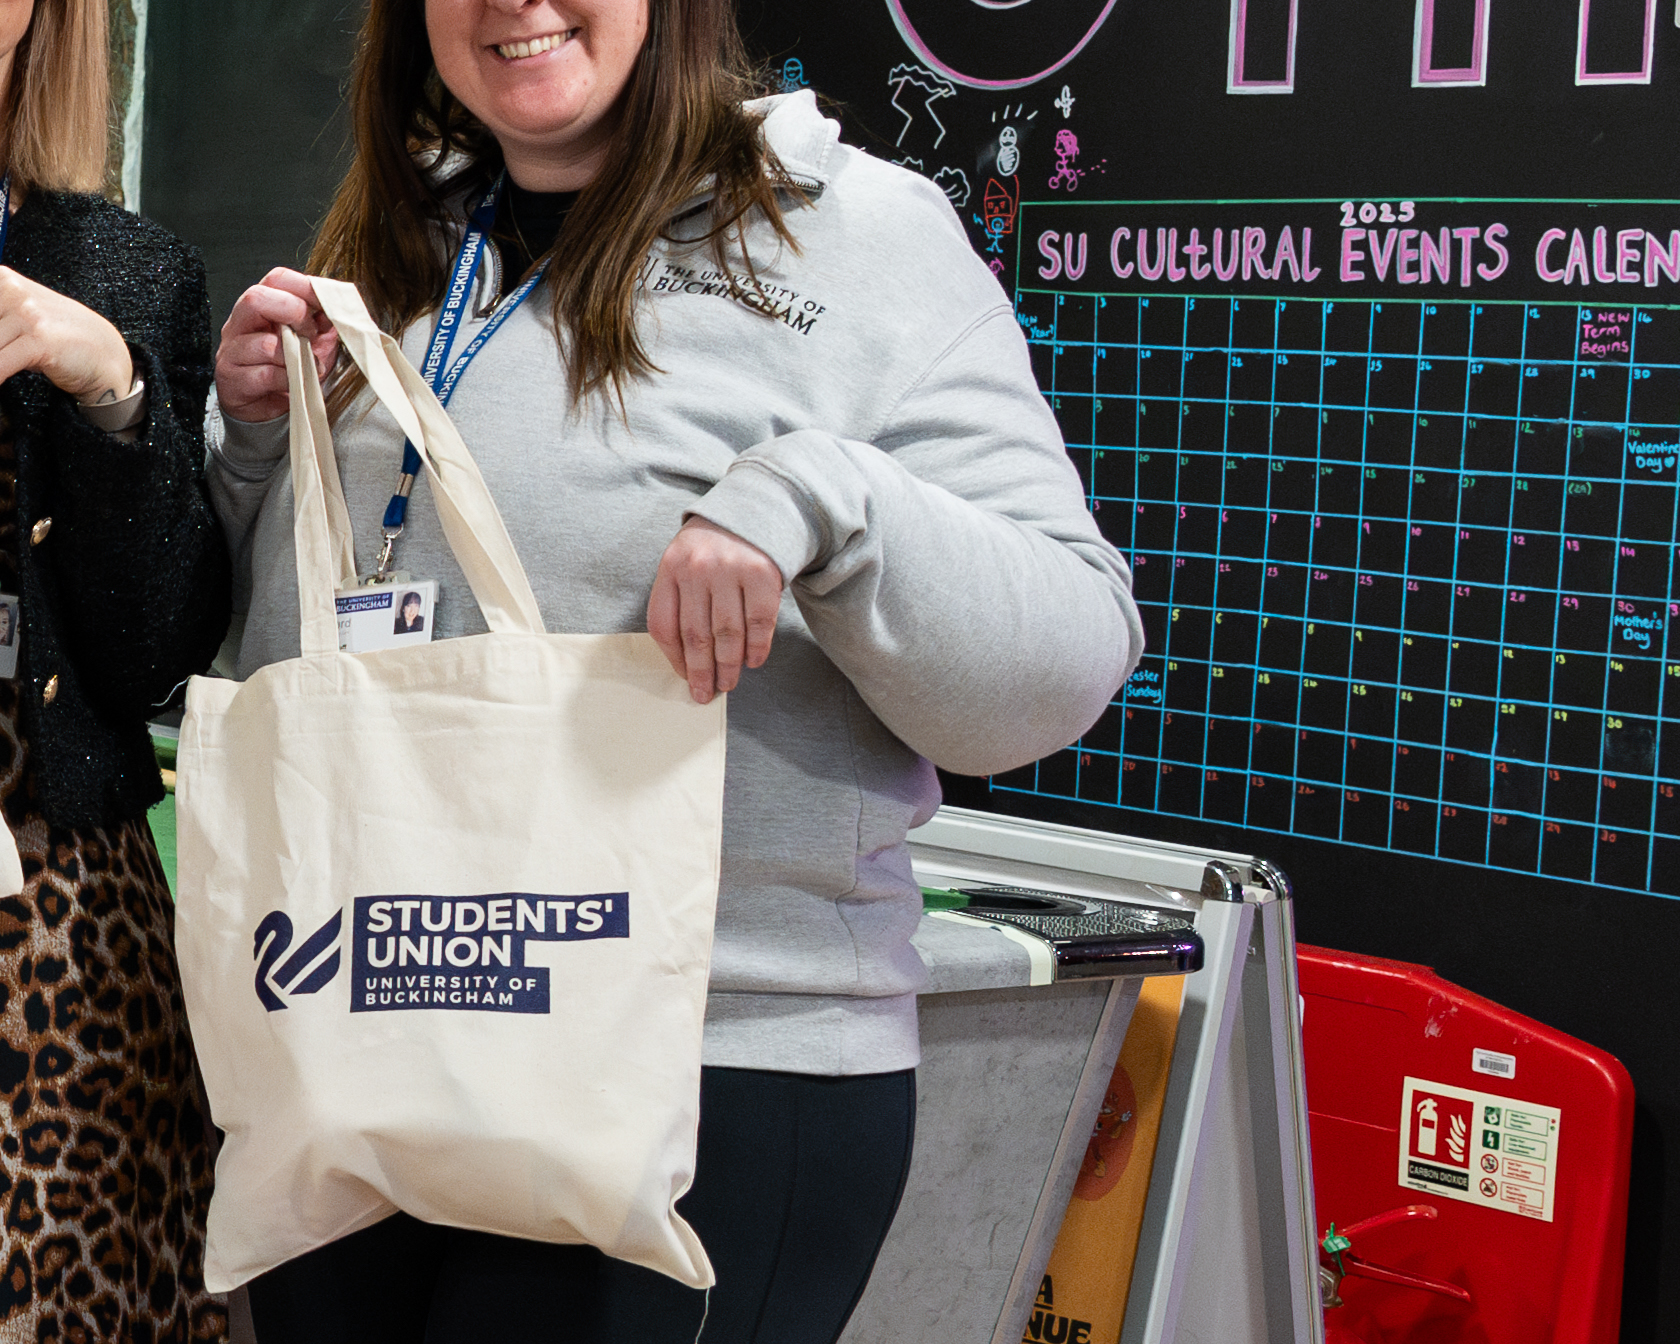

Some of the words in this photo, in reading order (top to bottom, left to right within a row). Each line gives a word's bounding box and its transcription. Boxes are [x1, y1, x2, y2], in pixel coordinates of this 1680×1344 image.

[1340, 201, 1416, 226] 2025
[1038, 227, 1088, 280] SU
[1341, 223, 1510, 287] EVENTS
[1536, 227, 1680, 288] CALEN
[446, 232, 482, 309] BUCKINGHAM
[664, 264, 696, 279] THE
[700, 270, 800, 302] UNIVERSITY
[804, 299, 827, 316] OF
[652, 276, 818, 337] BUCKINGHAM
[1581, 309, 1592, 321] 13
[441, 309, 456, 328] OF
[1582, 323, 1621, 339] Term
[423, 328, 451, 388] NIVERSITY
[1580, 341, 1629, 358] Begins
[1471, 363, 1484, 375] 27
[1580, 367, 1596, 379] 29
[1633, 369, 1651, 380] 30
[1573, 427, 1584, 438] 13
[1635, 456, 1663, 474] Day
[336, 599, 390, 613] BUCKINGHAM
[1617, 600, 1635, 614] 30
[1614, 610, 1663, 630] Mother's
[1622, 628, 1651, 650] Day
[1126, 684, 1163, 704] Sunday
[1607, 717, 1623, 729] 30
[365, 900, 613, 935] STUDENTS'
[365, 935, 513, 969] UNION
[365, 975, 502, 992] UNIVERSITY
[508, 976, 538, 992] OF
[365, 990, 515, 1007] BUCKINGHAM
[1409, 1164, 1440, 1182] CARBON
[1439, 1172, 1468, 1187] DIOXIDE
